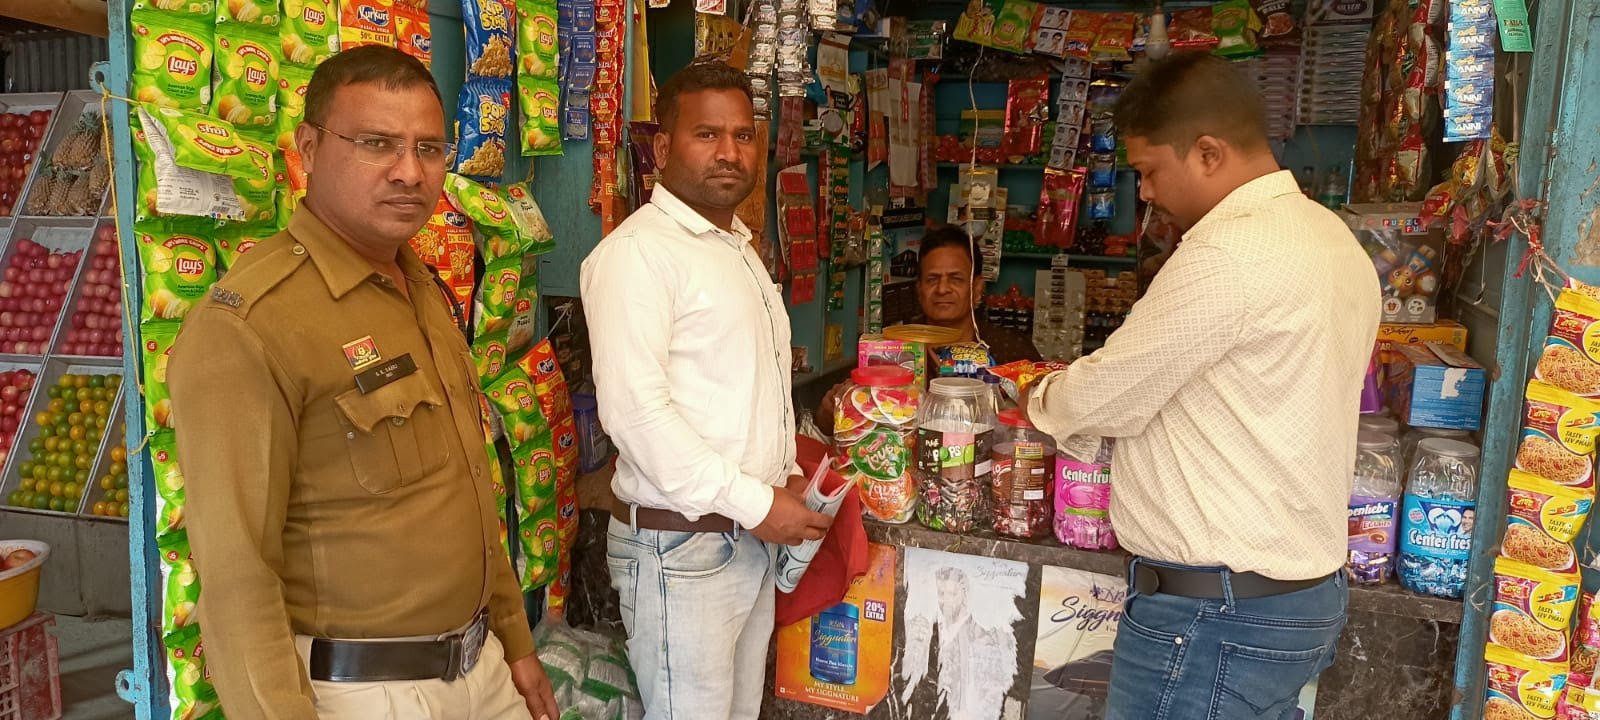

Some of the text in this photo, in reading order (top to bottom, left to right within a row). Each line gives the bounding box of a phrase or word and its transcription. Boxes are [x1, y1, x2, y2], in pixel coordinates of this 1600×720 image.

[305, 8, 325, 24] Lay's
[1461, 5, 1487, 15] ANNI
[482, 13, 507, 32] STAR
[360, 31, 373, 40] 50%
[1458, 34, 1485, 44] ANNI
[168, 57, 196, 76] Lay's
[1457, 63, 1483, 73] ANNI
[246, 67, 267, 85] Lay's
[1456, 92, 1483, 102] ANNI
[481, 103, 506, 121] POP
[481, 117, 506, 135] STAR
[1455, 121, 1482, 131] ANNI
[1382, 218, 1422, 227] PUZZL
[177, 258, 204, 275] Lay's
[1062, 466, 1092, 482] Center
[1548, 525, 1559, 533] SEV
[1408, 529, 1471, 551] Center fres
[865, 600, 886, 614] 20%
[1050, 596, 1121, 631] Siggn
[865, 610, 885, 621] EXTRA
